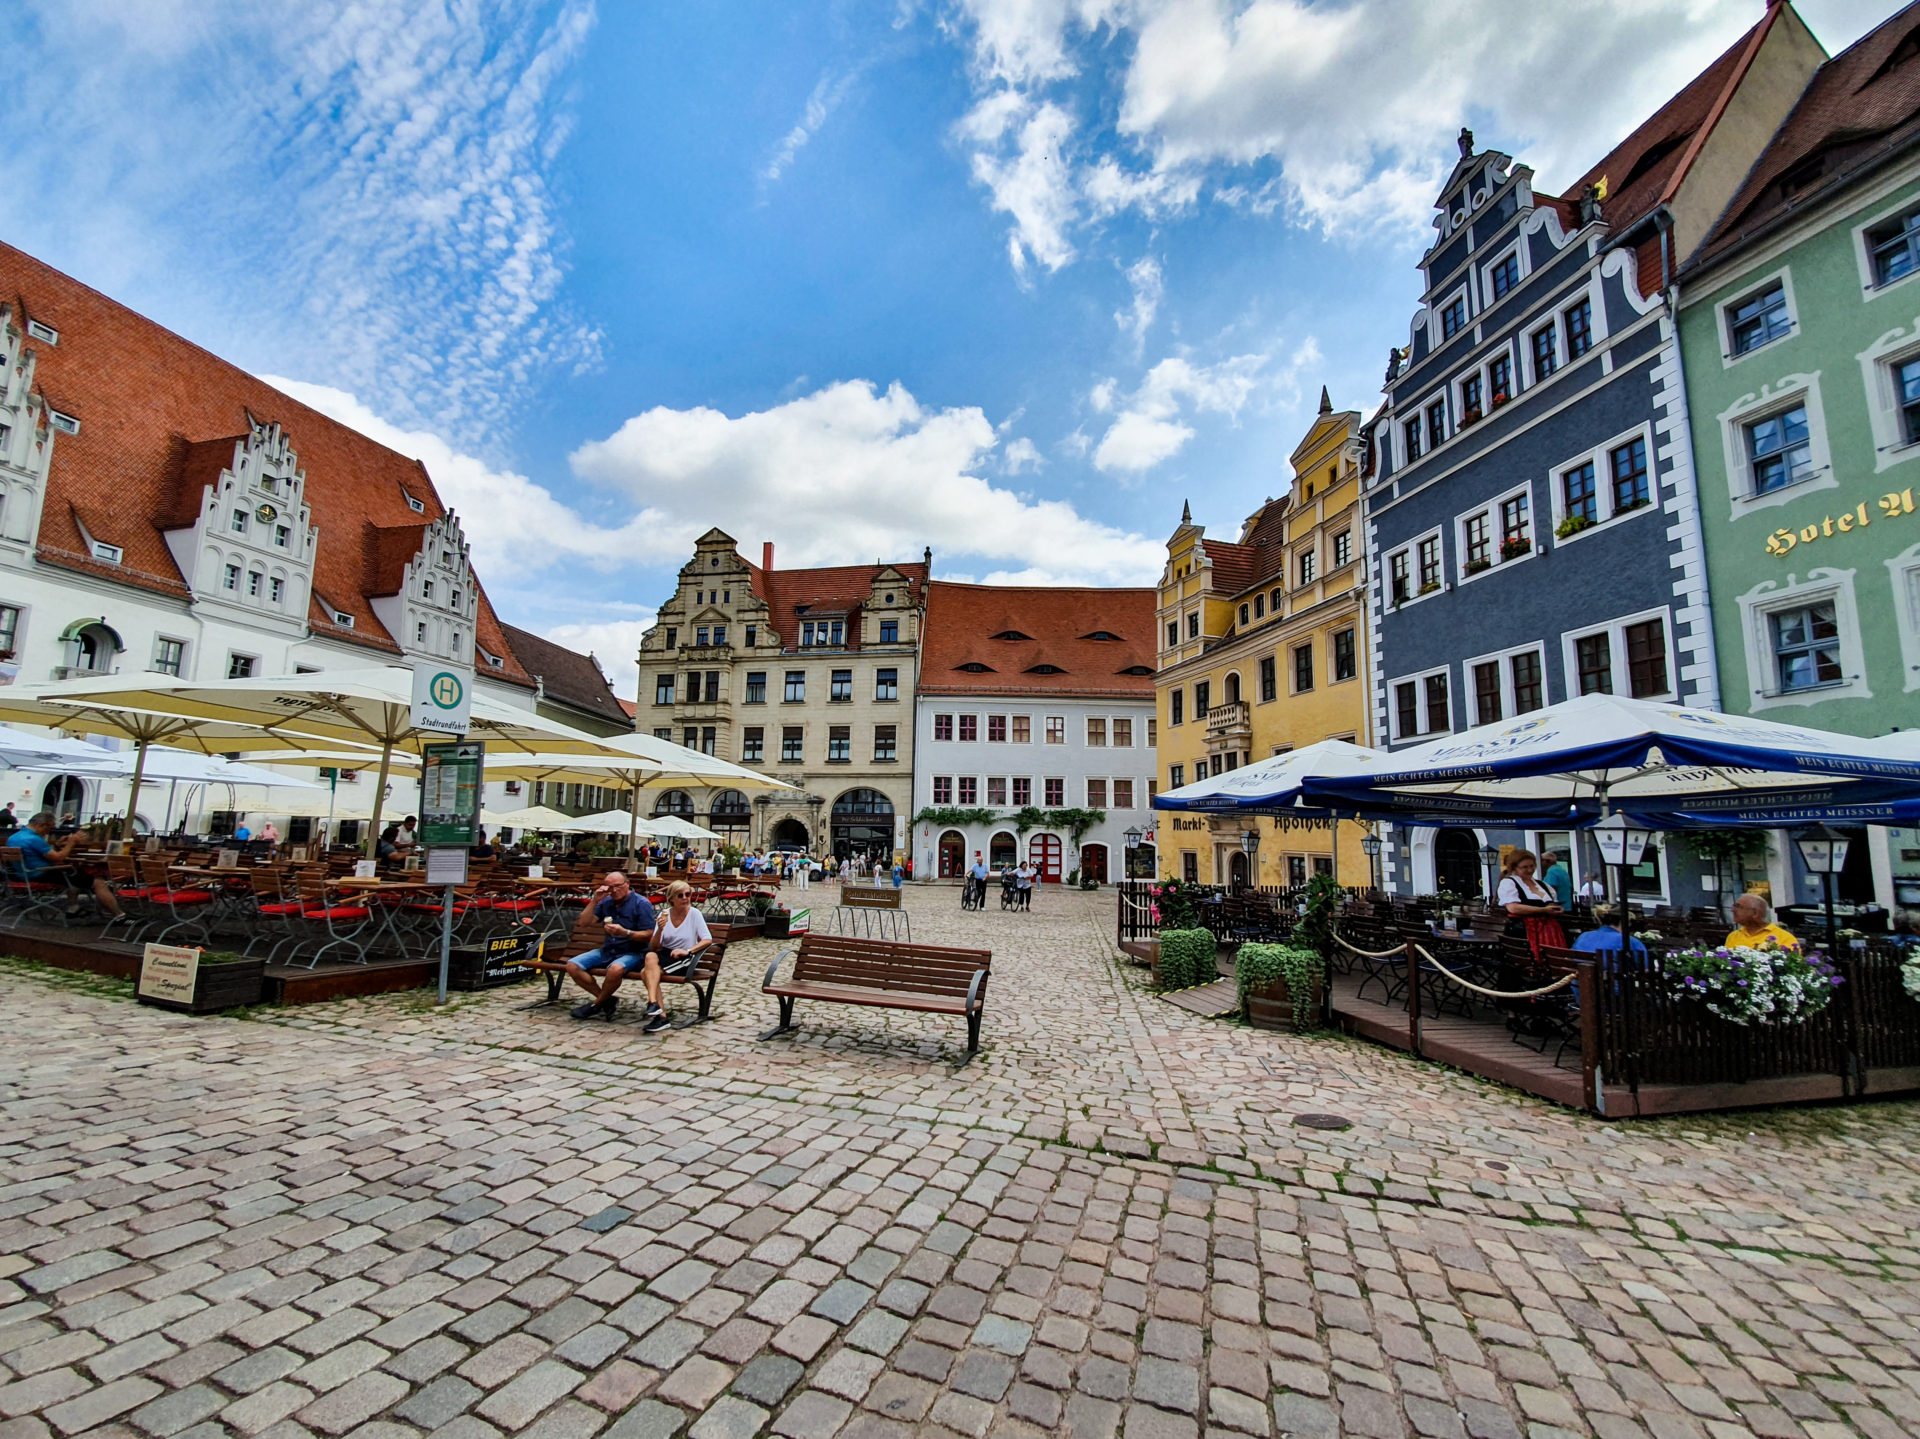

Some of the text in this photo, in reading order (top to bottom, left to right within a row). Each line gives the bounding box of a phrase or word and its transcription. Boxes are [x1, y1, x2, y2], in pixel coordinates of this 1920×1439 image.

[1766, 501, 1871, 558] Hotel
[421, 717, 467, 732] Stadtrundfahrt
[1796, 756, 1826, 767] MEIN
[1829, 759, 1869, 771] ECHTES
[1374, 765, 1494, 783] MEIN ECHTES MEISSNER
[1739, 807, 1895, 819] MEIN ECHTES MEISSNER
[1274, 817, 1338, 834] Apothek
[490, 938, 518, 951] BIER
